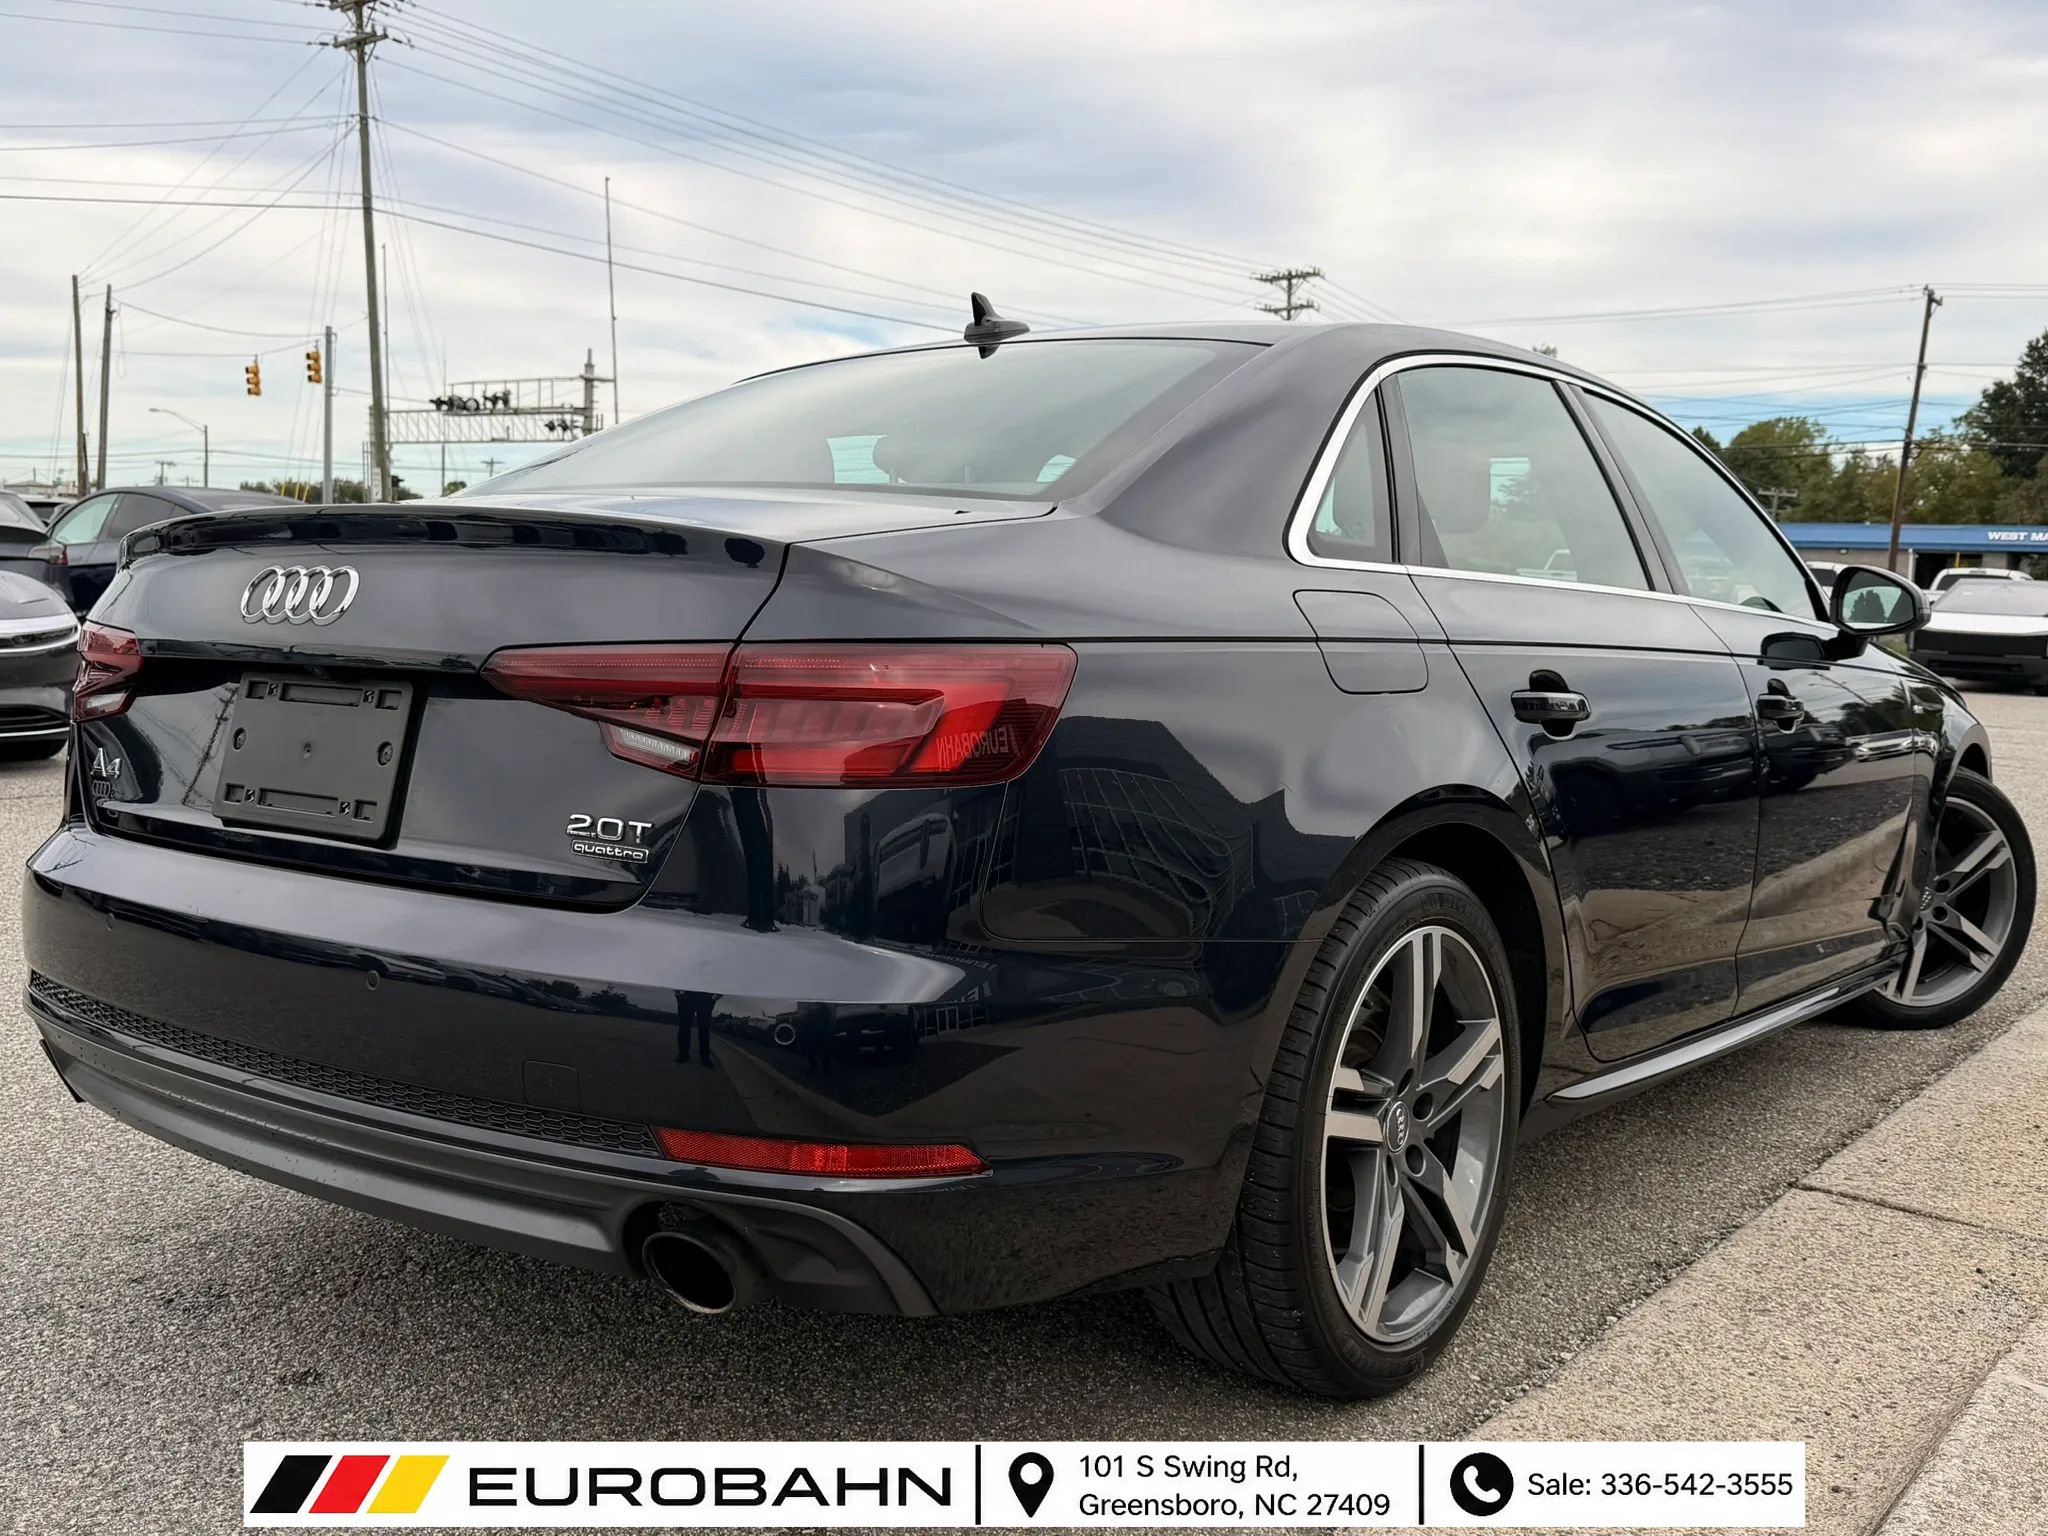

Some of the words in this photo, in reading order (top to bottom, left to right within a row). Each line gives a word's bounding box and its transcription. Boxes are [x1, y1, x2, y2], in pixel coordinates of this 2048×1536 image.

[1988, 531, 2028, 540] WEST
[90, 747, 121, 778] A4
[566, 814, 653, 844] 2.0T
[574, 843, 645, 859] quattro
